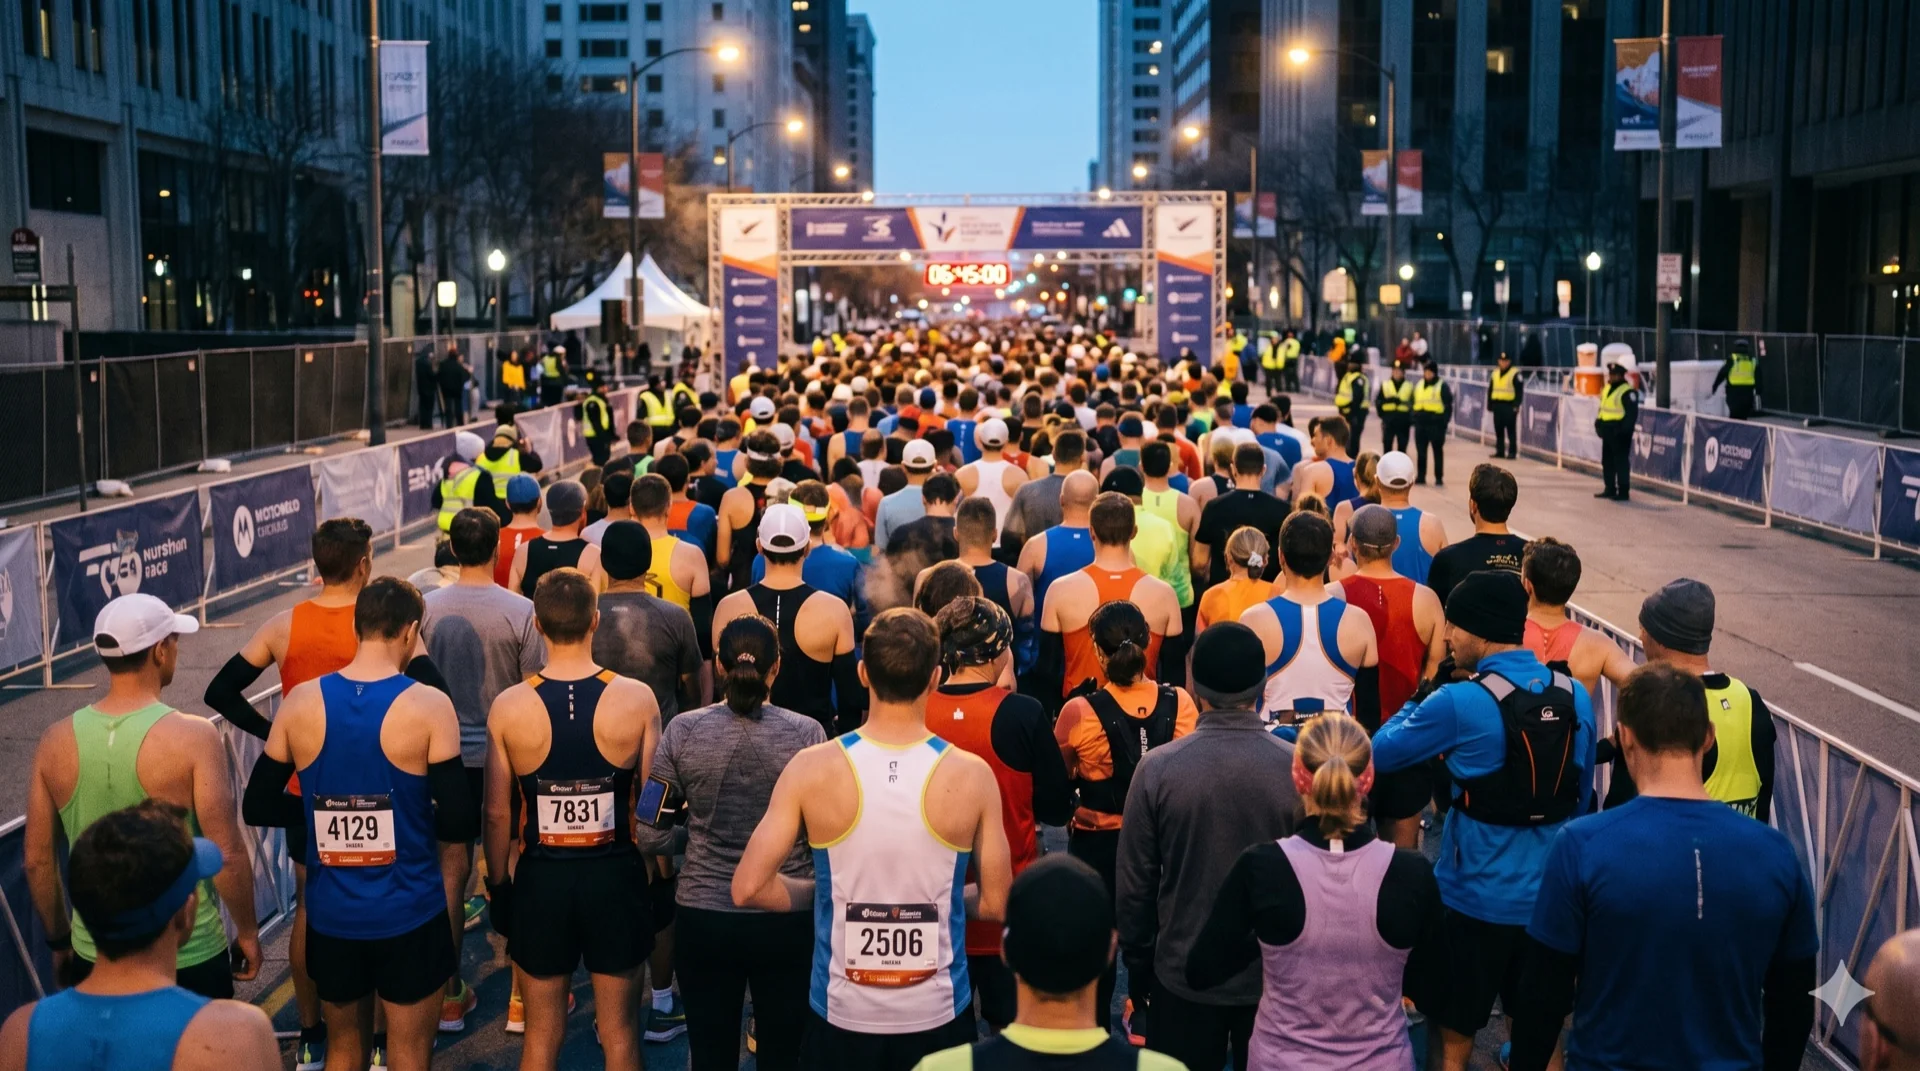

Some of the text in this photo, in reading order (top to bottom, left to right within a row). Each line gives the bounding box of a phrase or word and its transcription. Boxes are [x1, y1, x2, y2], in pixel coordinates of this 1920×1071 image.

[550, 797, 599, 824] 7831
[327, 815, 378, 841] 4129
[860, 927, 923, 957] 2506
